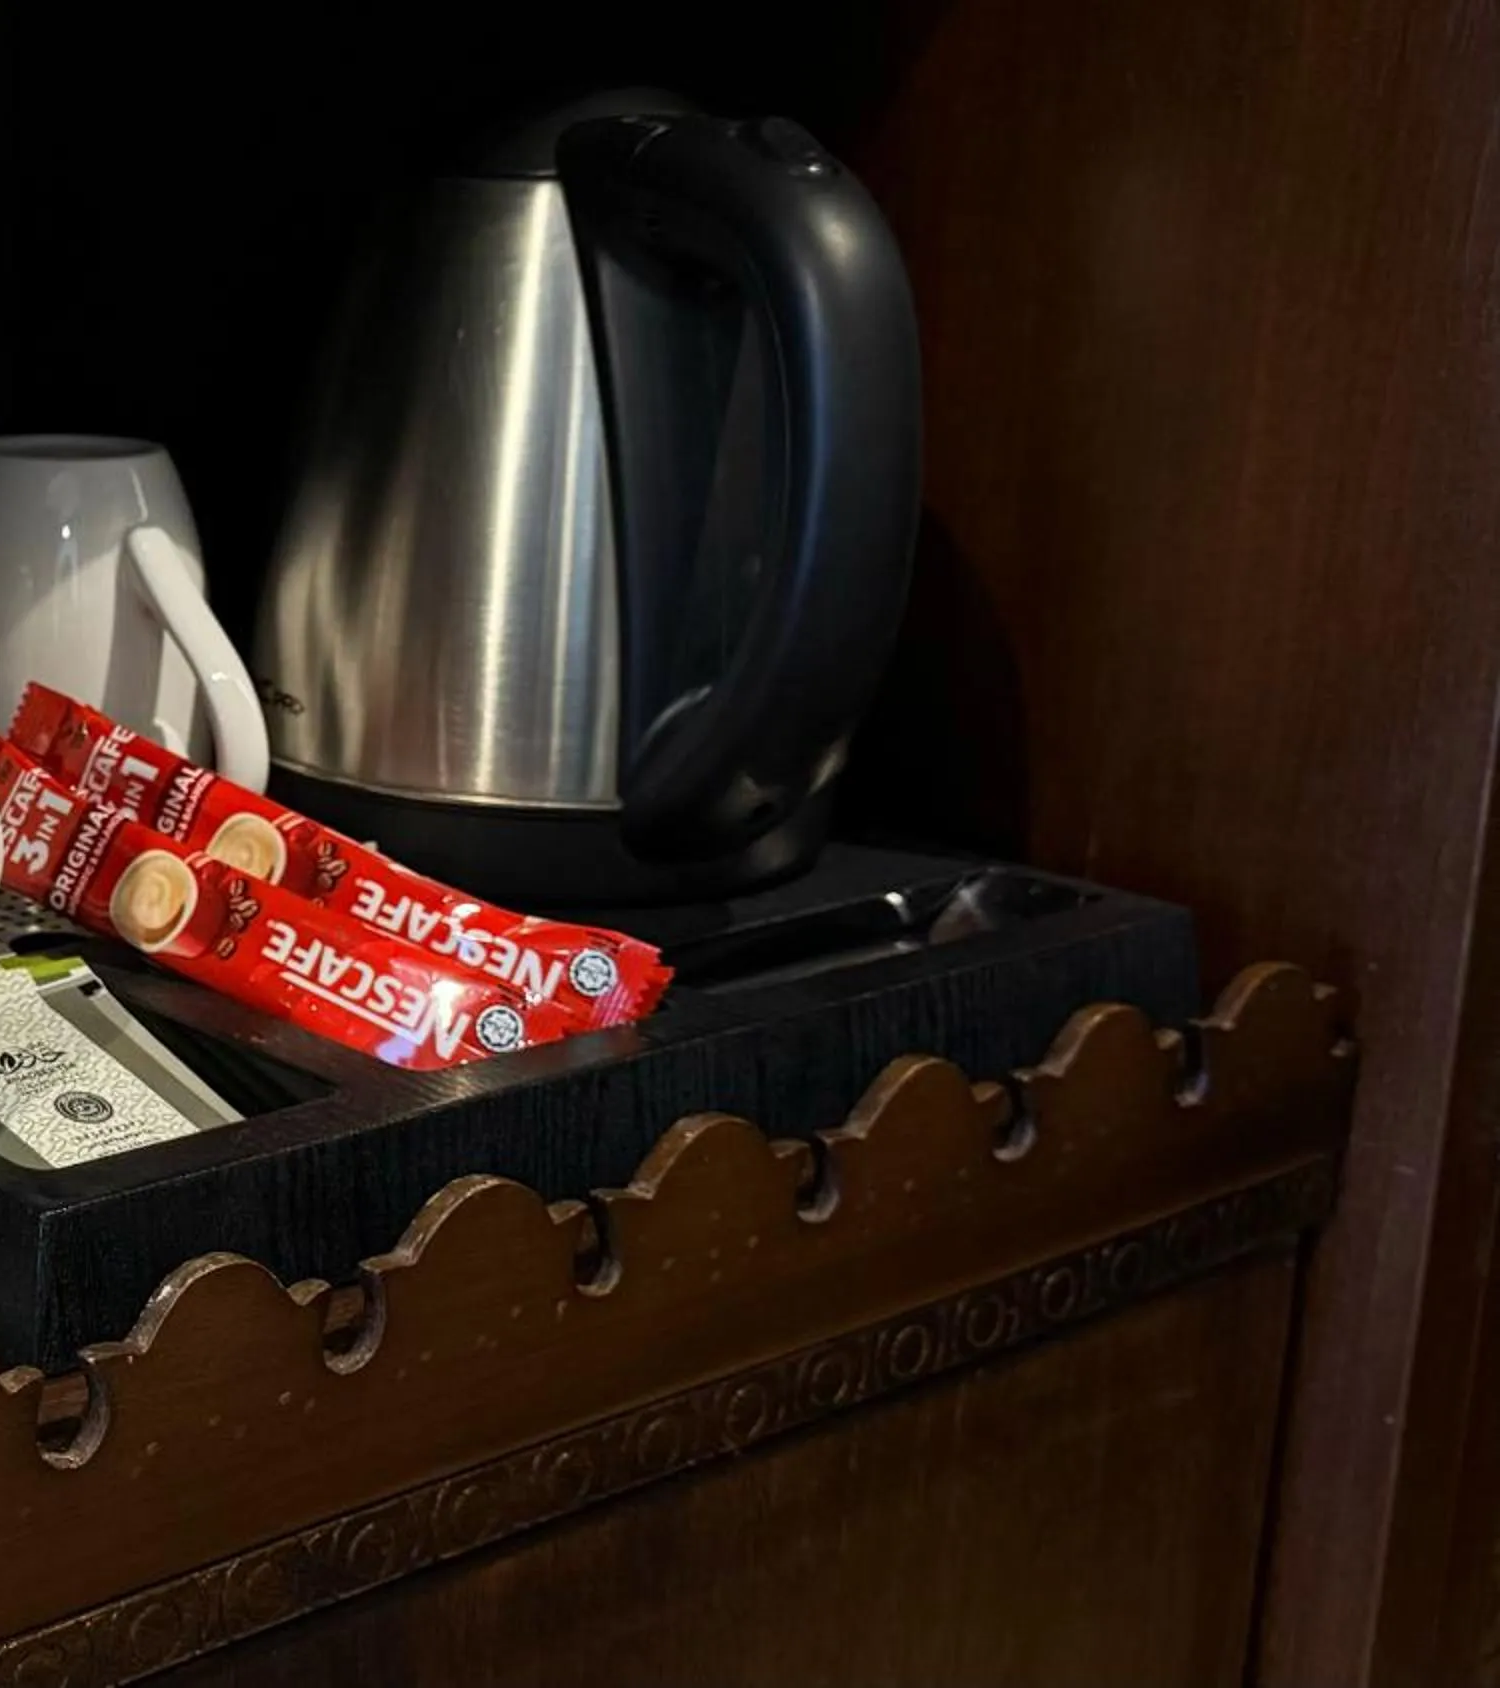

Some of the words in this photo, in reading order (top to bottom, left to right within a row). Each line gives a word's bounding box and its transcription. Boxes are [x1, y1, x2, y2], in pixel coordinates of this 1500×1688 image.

[119, 756, 160, 782] 1
[36, 787, 74, 816] 1
[156, 766, 204, 834] GINAL
[35, 812, 61, 841] IN
[9, 834, 49, 875] 3
[50, 800, 117, 911] ORIGINAL
